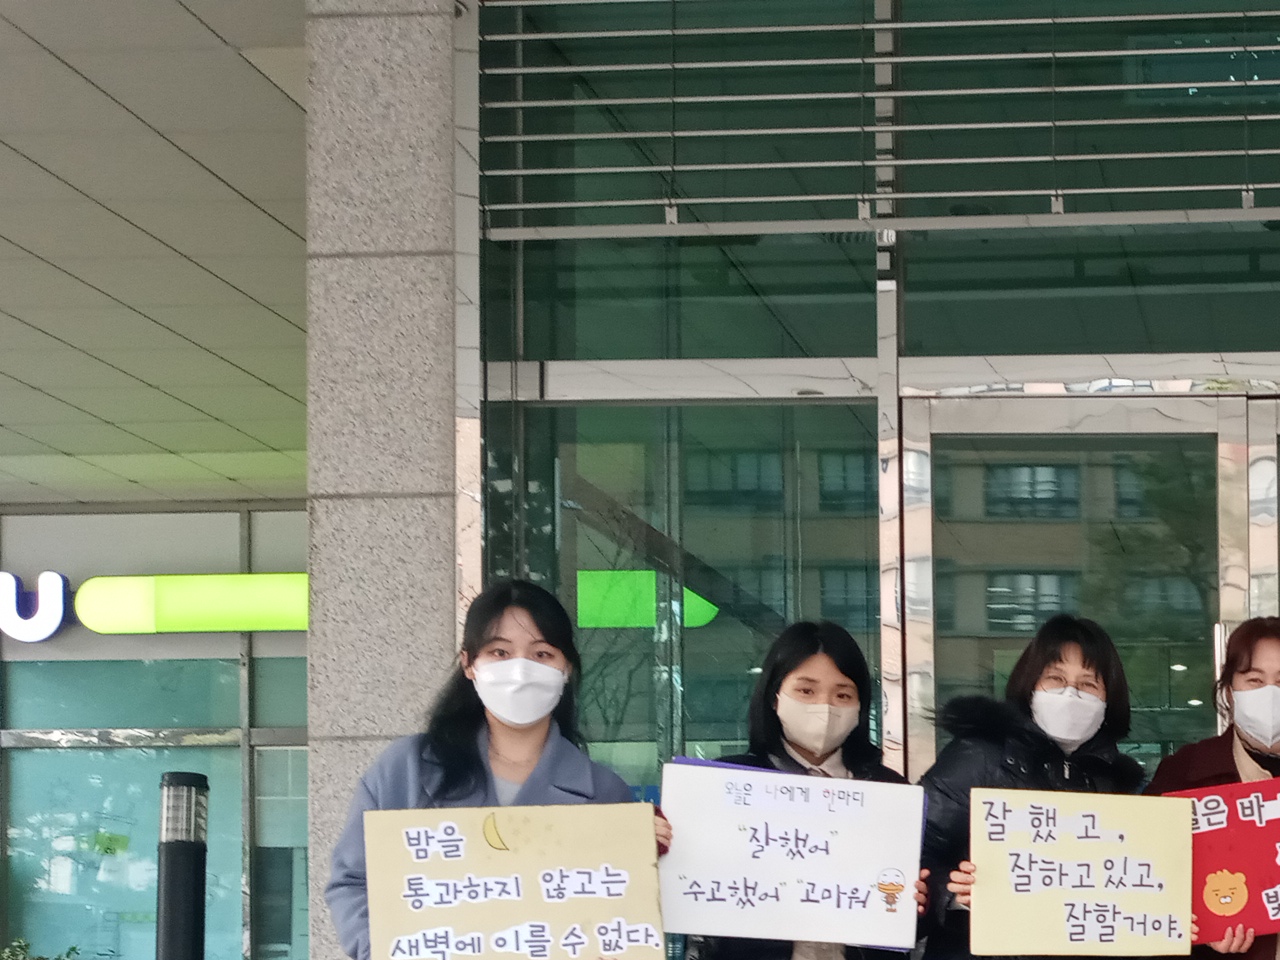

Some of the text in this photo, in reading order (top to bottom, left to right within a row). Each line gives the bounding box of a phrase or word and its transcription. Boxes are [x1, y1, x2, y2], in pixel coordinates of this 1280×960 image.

[765, 785, 811, 803] 나에게
[822, 788, 865, 812] 한마디
[405, 825, 464, 860] 밤을
[402, 866, 627, 910] 통과하지 않고는
[391, 921, 661, 960] 새벽에 이를 수 없다.
[1064, 903, 1183, 943] 잘할거야.
